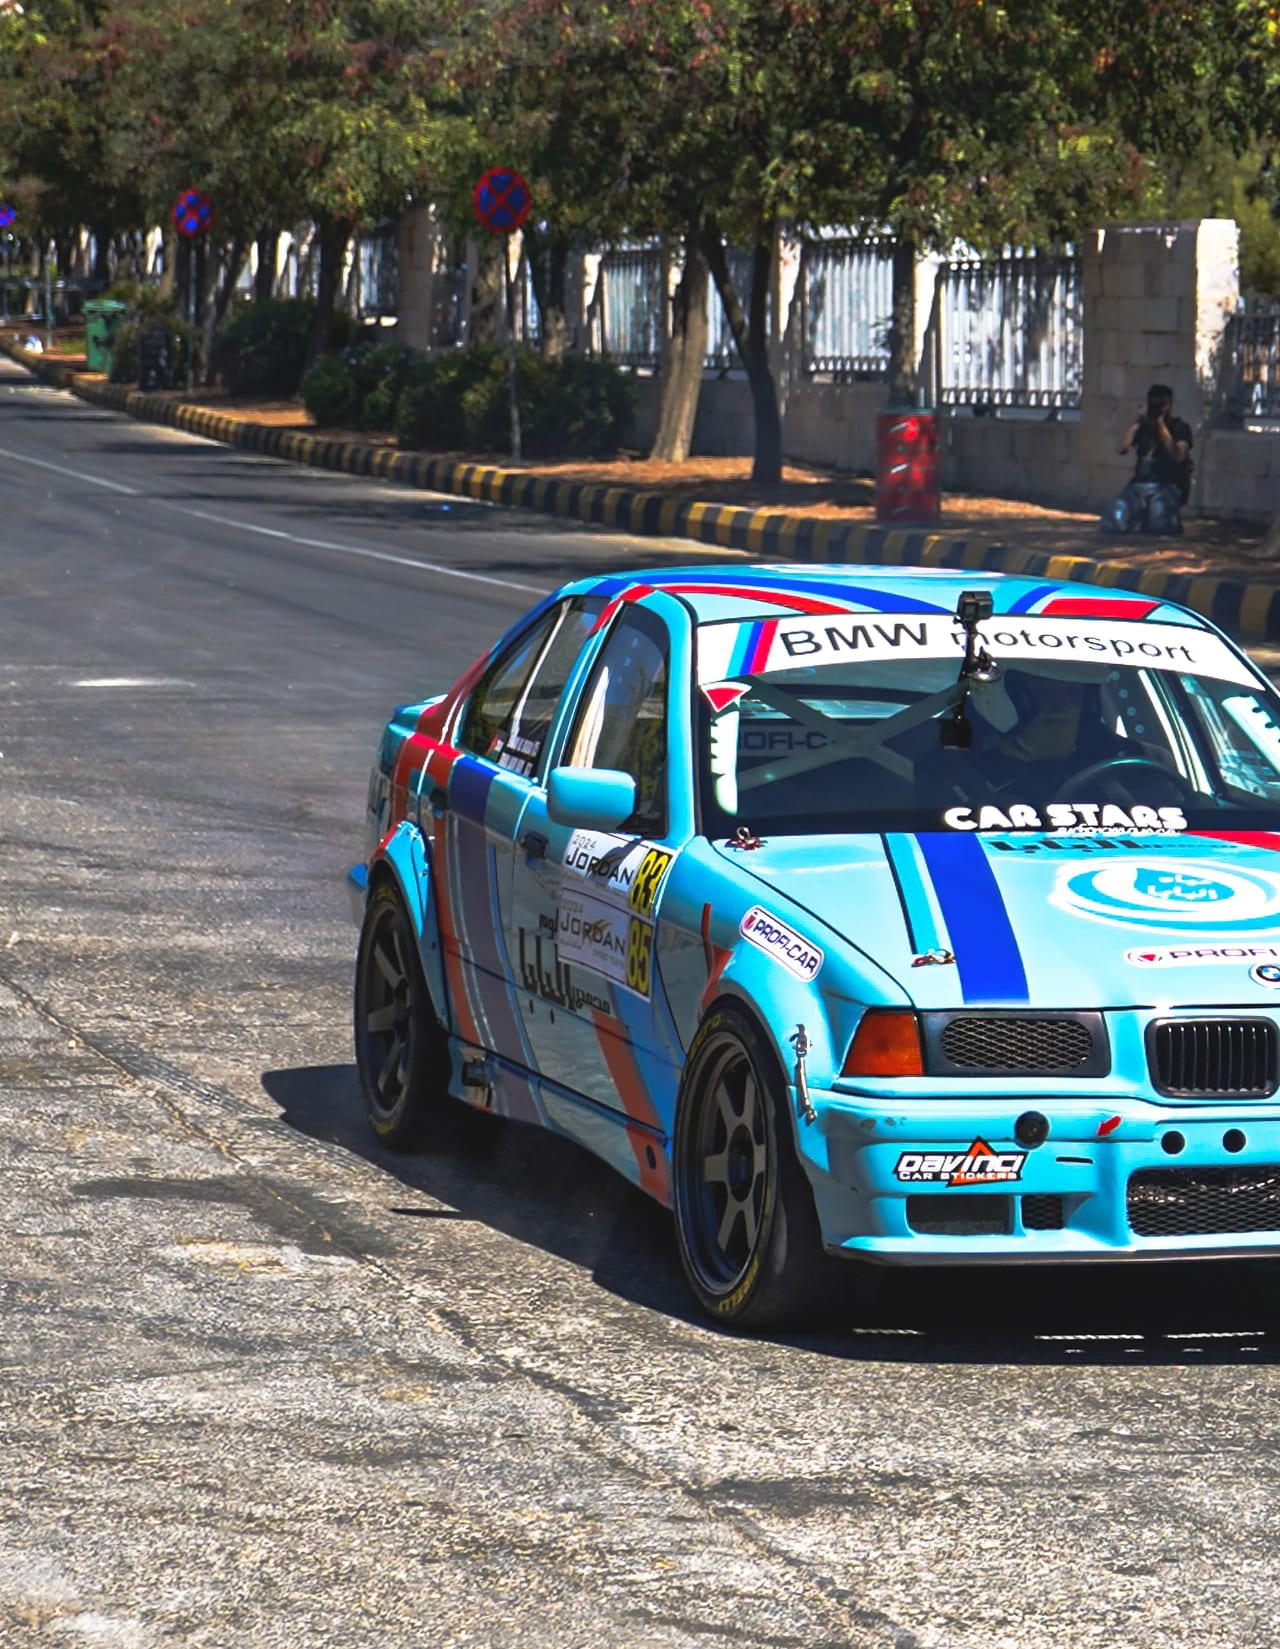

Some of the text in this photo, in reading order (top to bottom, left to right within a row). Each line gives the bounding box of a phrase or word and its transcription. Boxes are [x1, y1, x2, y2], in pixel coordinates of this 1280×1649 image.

[780, 622, 1197, 663] BMW motorsport
[944, 803, 1188, 830] CAR STARS
[565, 846, 635, 886] JORDAN
[629, 850, 670, 918] 83
[560, 912, 626, 954] JORDAN
[753, 918, 818, 974] PROFI-CAR
[626, 917, 653, 996] 85
